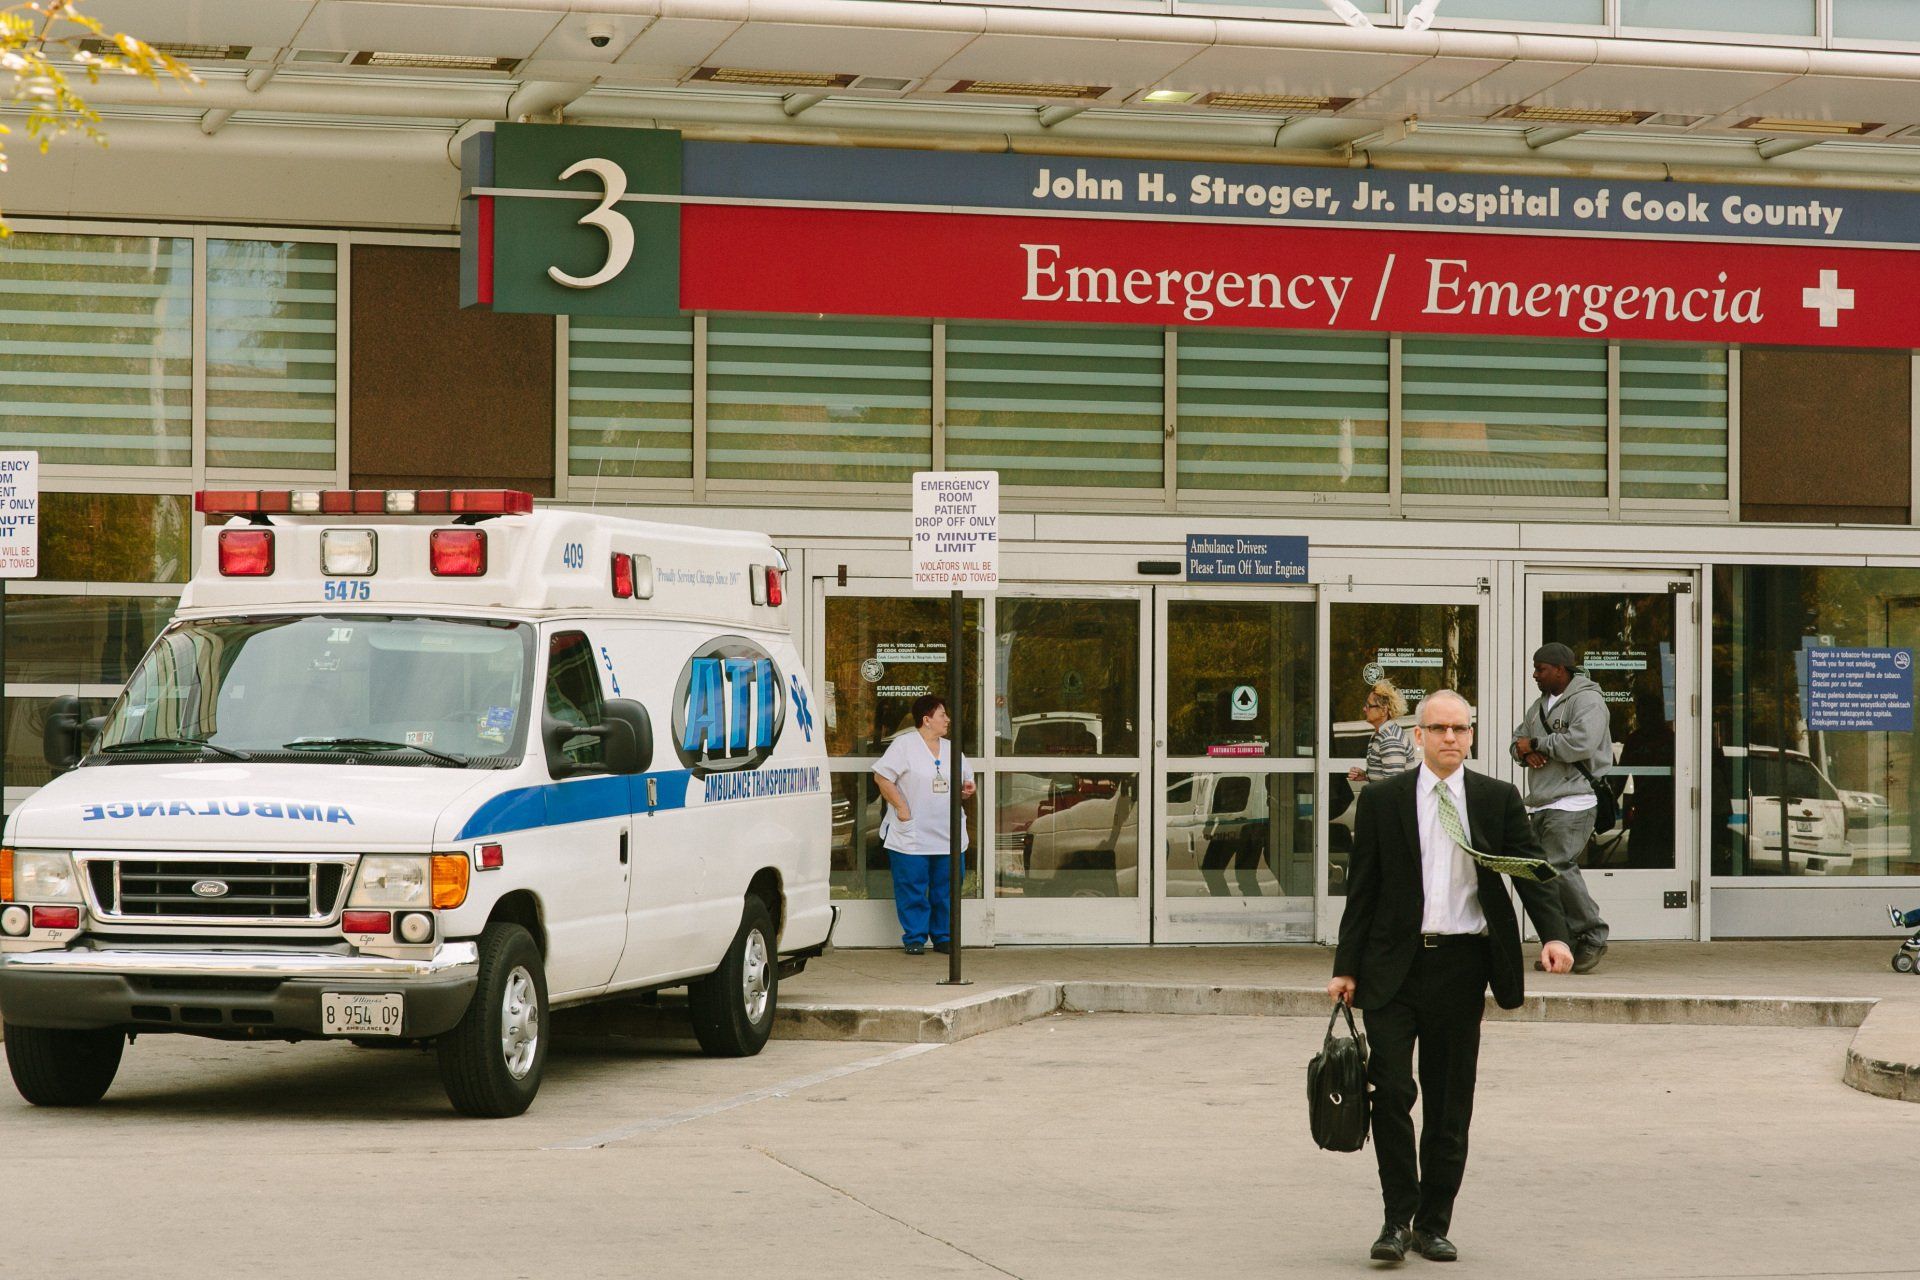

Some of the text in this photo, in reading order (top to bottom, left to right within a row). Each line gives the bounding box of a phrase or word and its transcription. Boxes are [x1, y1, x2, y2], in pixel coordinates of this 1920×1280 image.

[1032, 168, 1844, 235] John H. Stroger, Jr. Hospital of Cook County
[547, 157, 635, 290] 3
[1019, 243, 1764, 333] Emergency / Emergencia
[921, 480, 990, 491] EMERGENCY
[939, 492, 973, 502] ROOM
[10, 499, 35, 509] ONLY
[934, 505, 976, 515] PATIENT
[915, 516, 996, 527] DROP OFF ONLY
[915, 532, 997, 541] 10 MINUTE
[2, 547, 30, 555] WILL BE
[935, 543, 976, 552] LIMIT
[1190, 538, 1268, 555] Ambulance Drivers:
[563, 543, 584, 568] 409
[9, 559, 34, 568] TOWED
[920, 561, 992, 571] VIOLATORS WILL BE
[1190, 559, 1306, 578] Please Turn Off Your Engines
[915, 573, 997, 582] TICKETED AND TOWED
[324, 581, 370, 600] 5475
[1811, 650, 1829, 660] Stroger
[1812, 659, 1826, 667] Thank
[1828, 661, 1837, 669] you
[1811, 670, 1830, 679] Stroger
[683, 656, 775, 752] ATI
[1821, 700, 1838, 709] Stroger
[704, 773, 751, 803] AMBULANCE
[752, 767, 808, 798] TRANSPORTATION
[326, 1005, 399, 1025] 8 954 09
